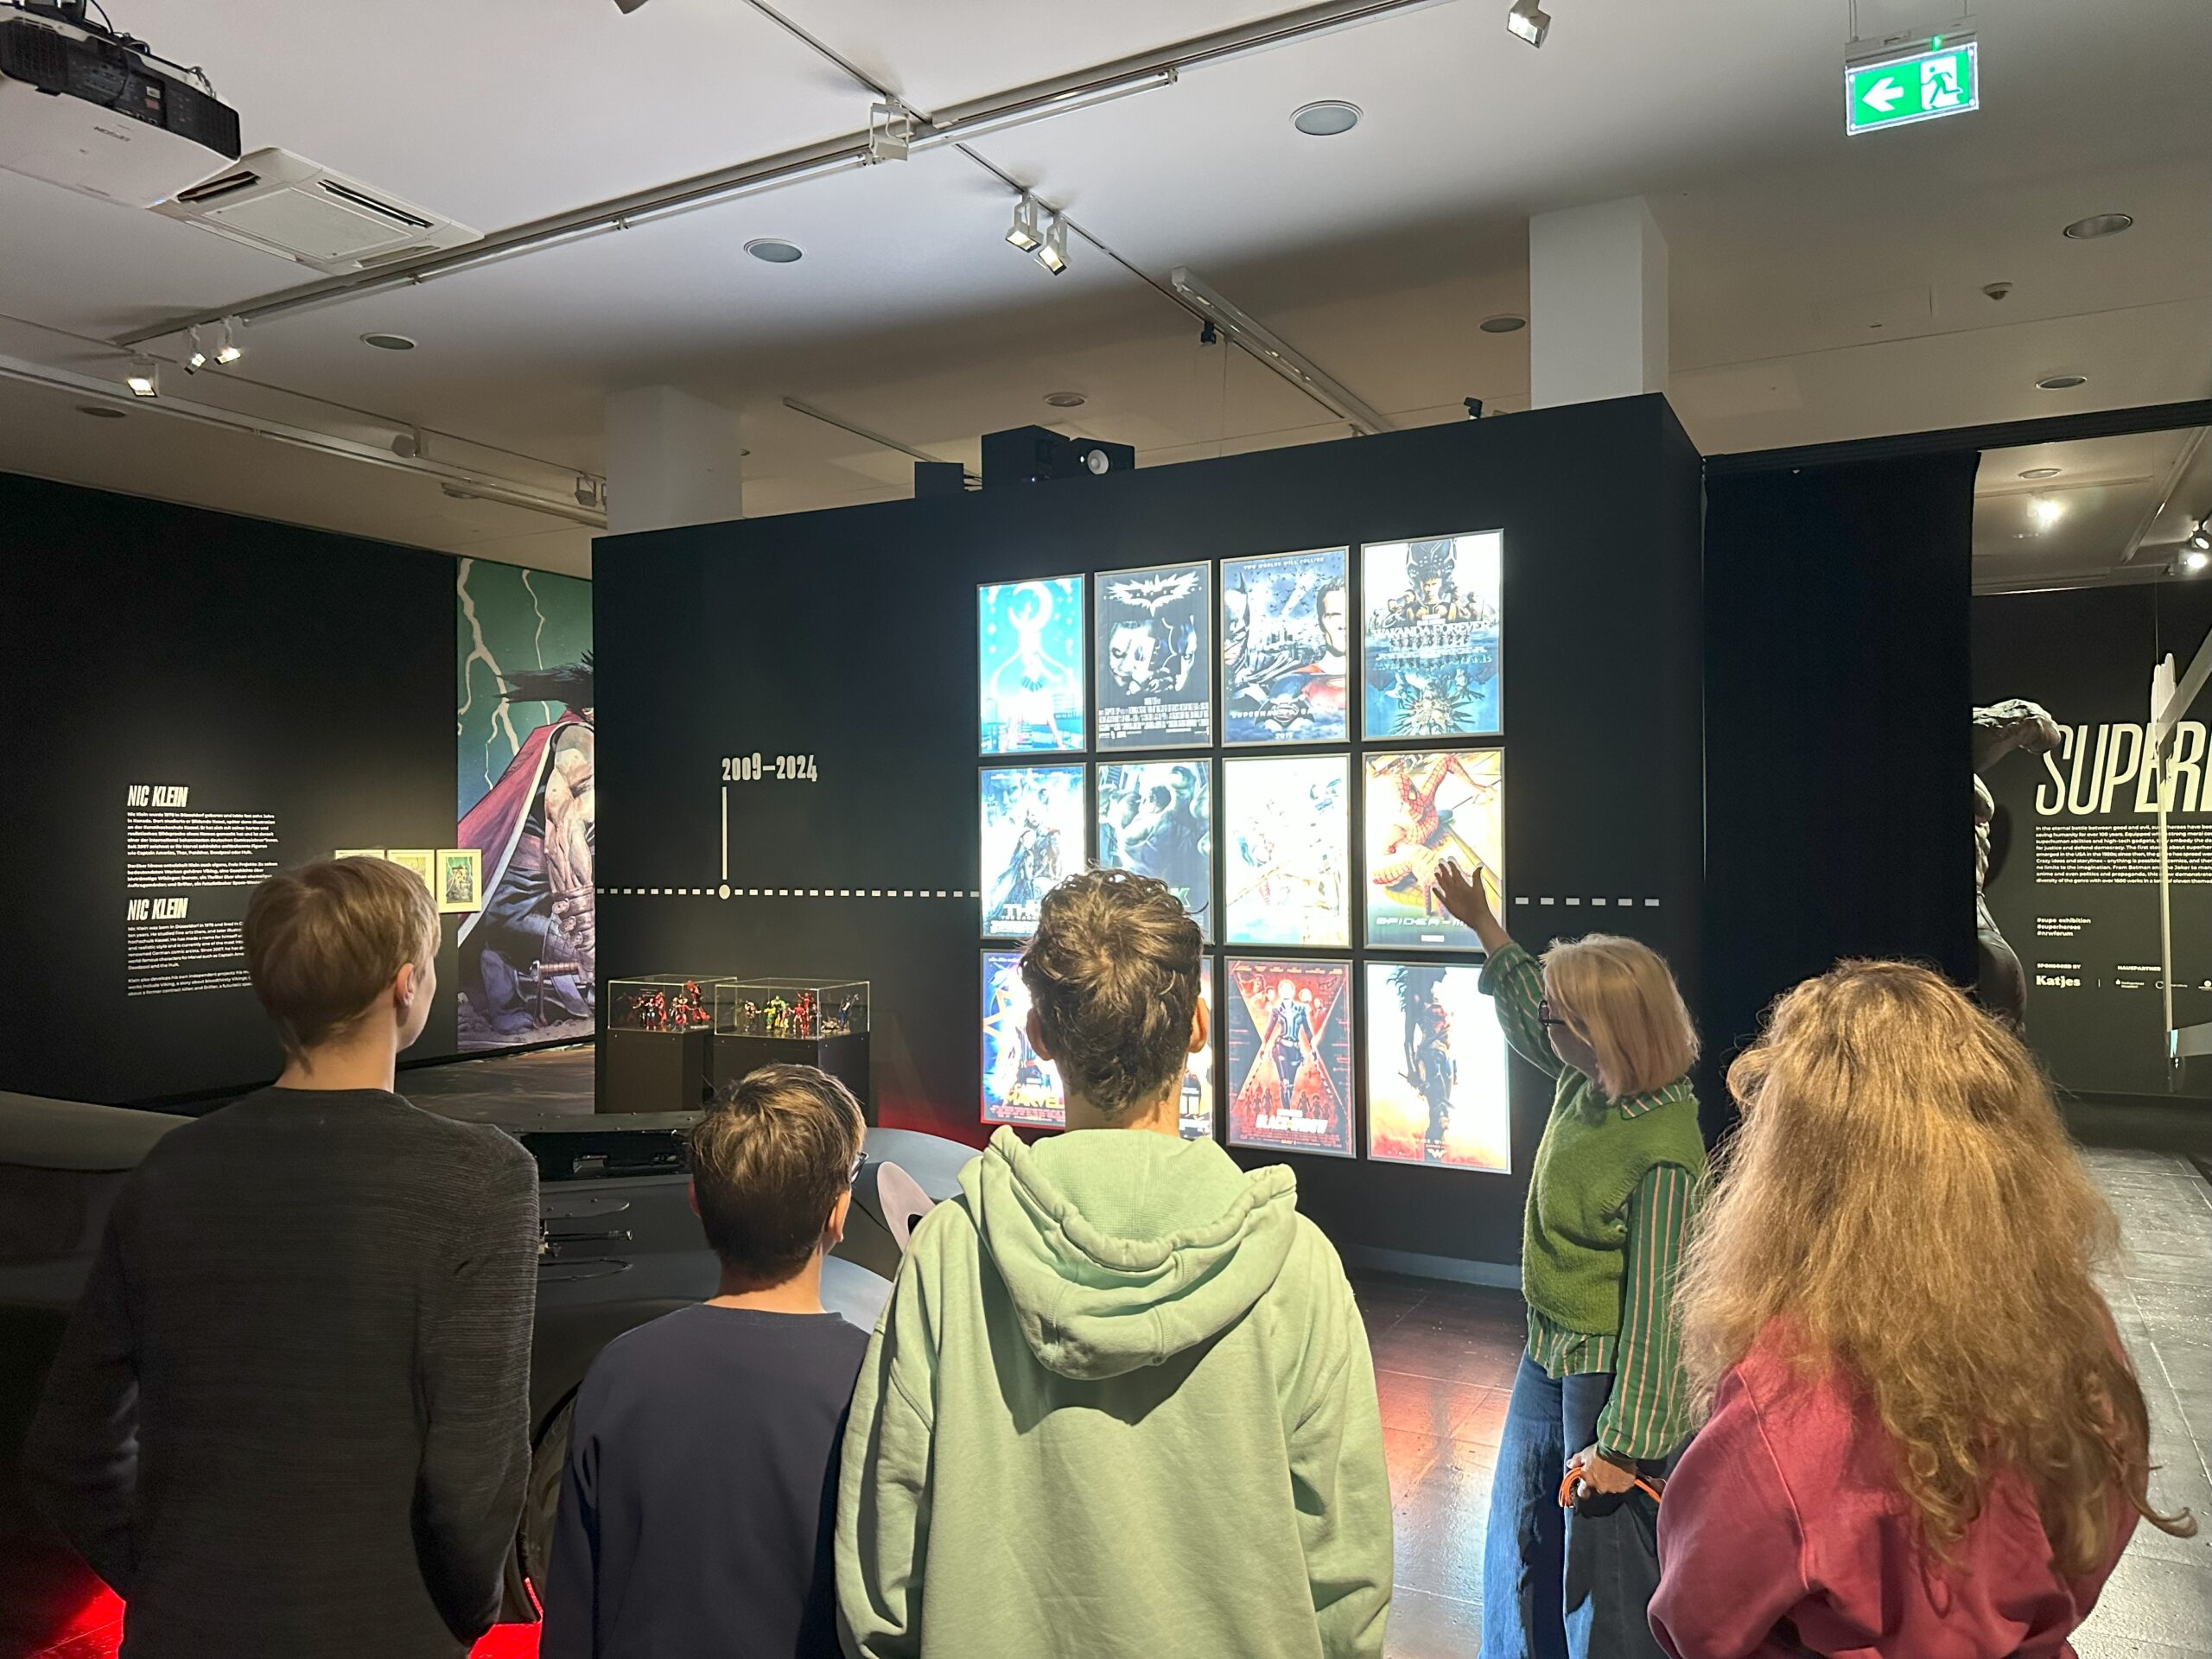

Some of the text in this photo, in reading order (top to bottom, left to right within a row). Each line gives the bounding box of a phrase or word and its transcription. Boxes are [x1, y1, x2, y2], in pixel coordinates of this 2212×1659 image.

[1433, 620, 1491, 634] FOREVER
[127, 785, 188, 808] NIC KLEIN
[127, 897, 188, 920] NIC KLEIN
[1376, 917, 1467, 926] SPIDER-M
[2036, 975, 2082, 988] Katjes
